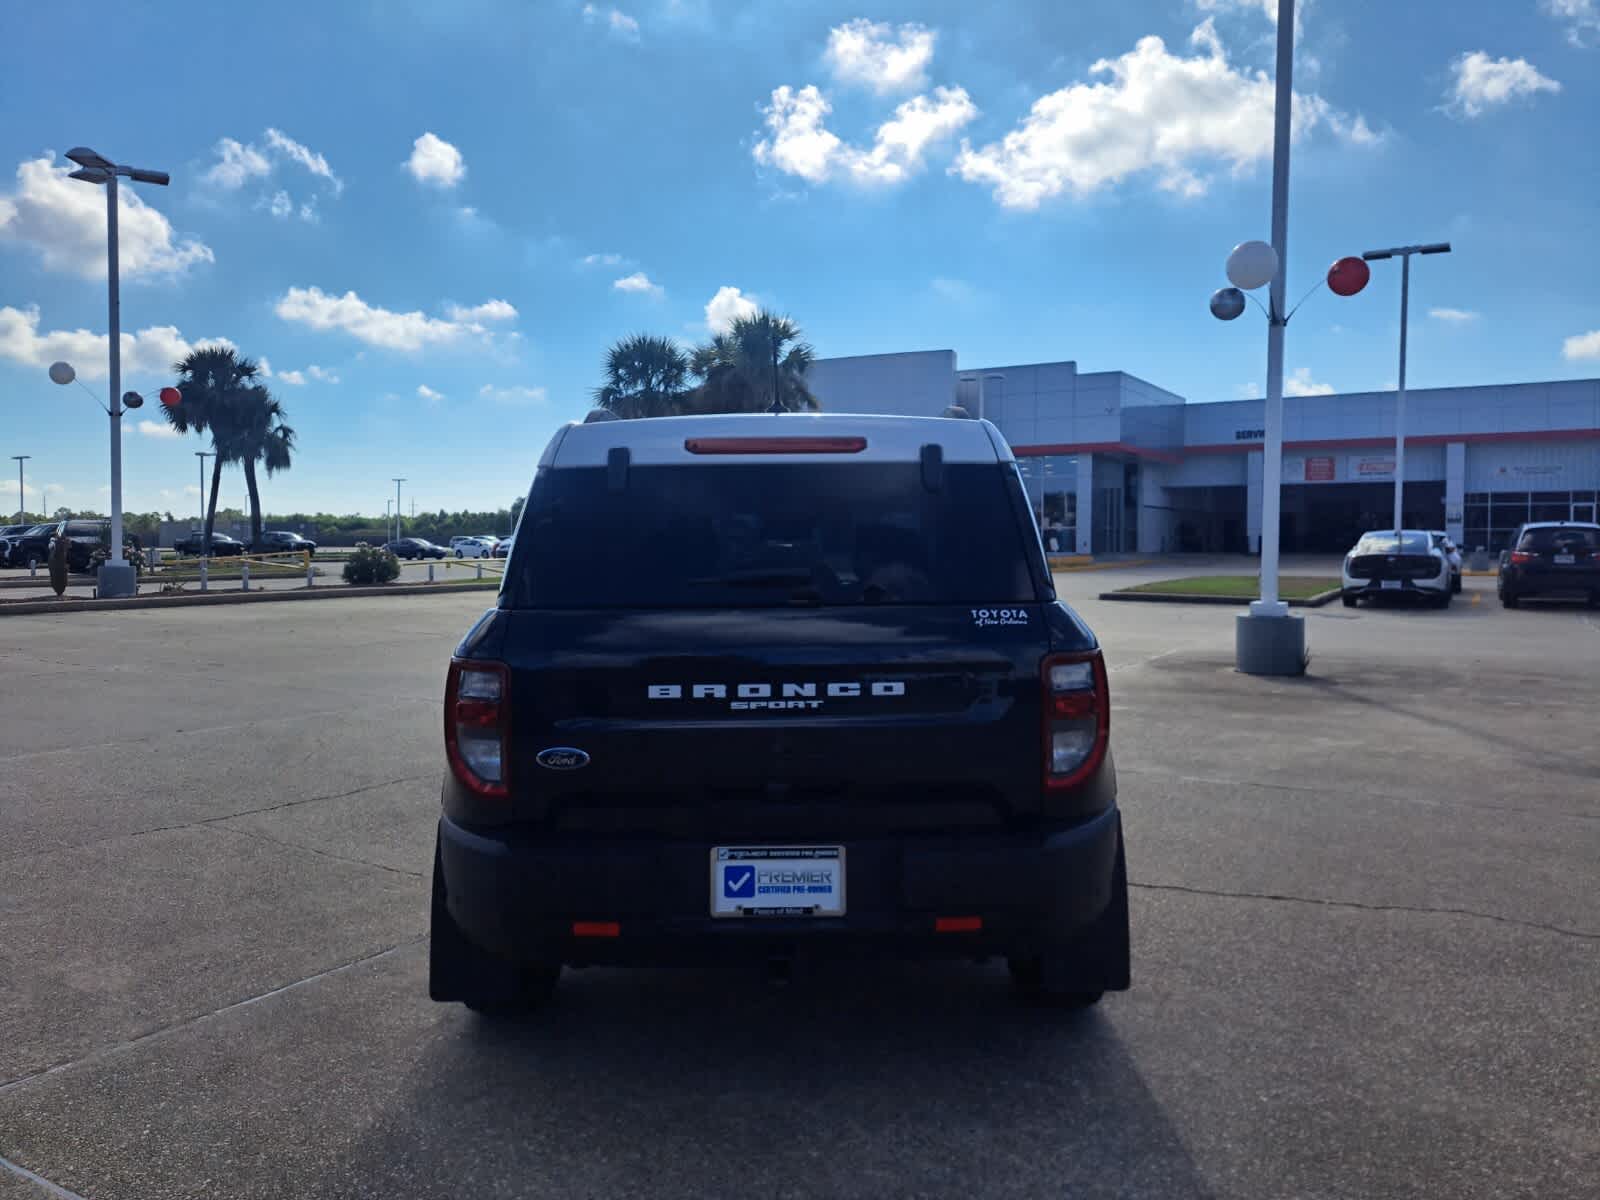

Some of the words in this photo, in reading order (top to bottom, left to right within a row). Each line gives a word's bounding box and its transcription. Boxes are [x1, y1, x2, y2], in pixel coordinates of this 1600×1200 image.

[971, 609, 1028, 618] TOYOTA
[648, 681, 905, 699] BRONCO
[730, 700, 824, 710] SPORT
[546, 752, 577, 765] Ford
[758, 871, 832, 883] PREMIER
[758, 886, 791, 894] CERTIFIED
[793, 886, 832, 894] PRE-OWNED
